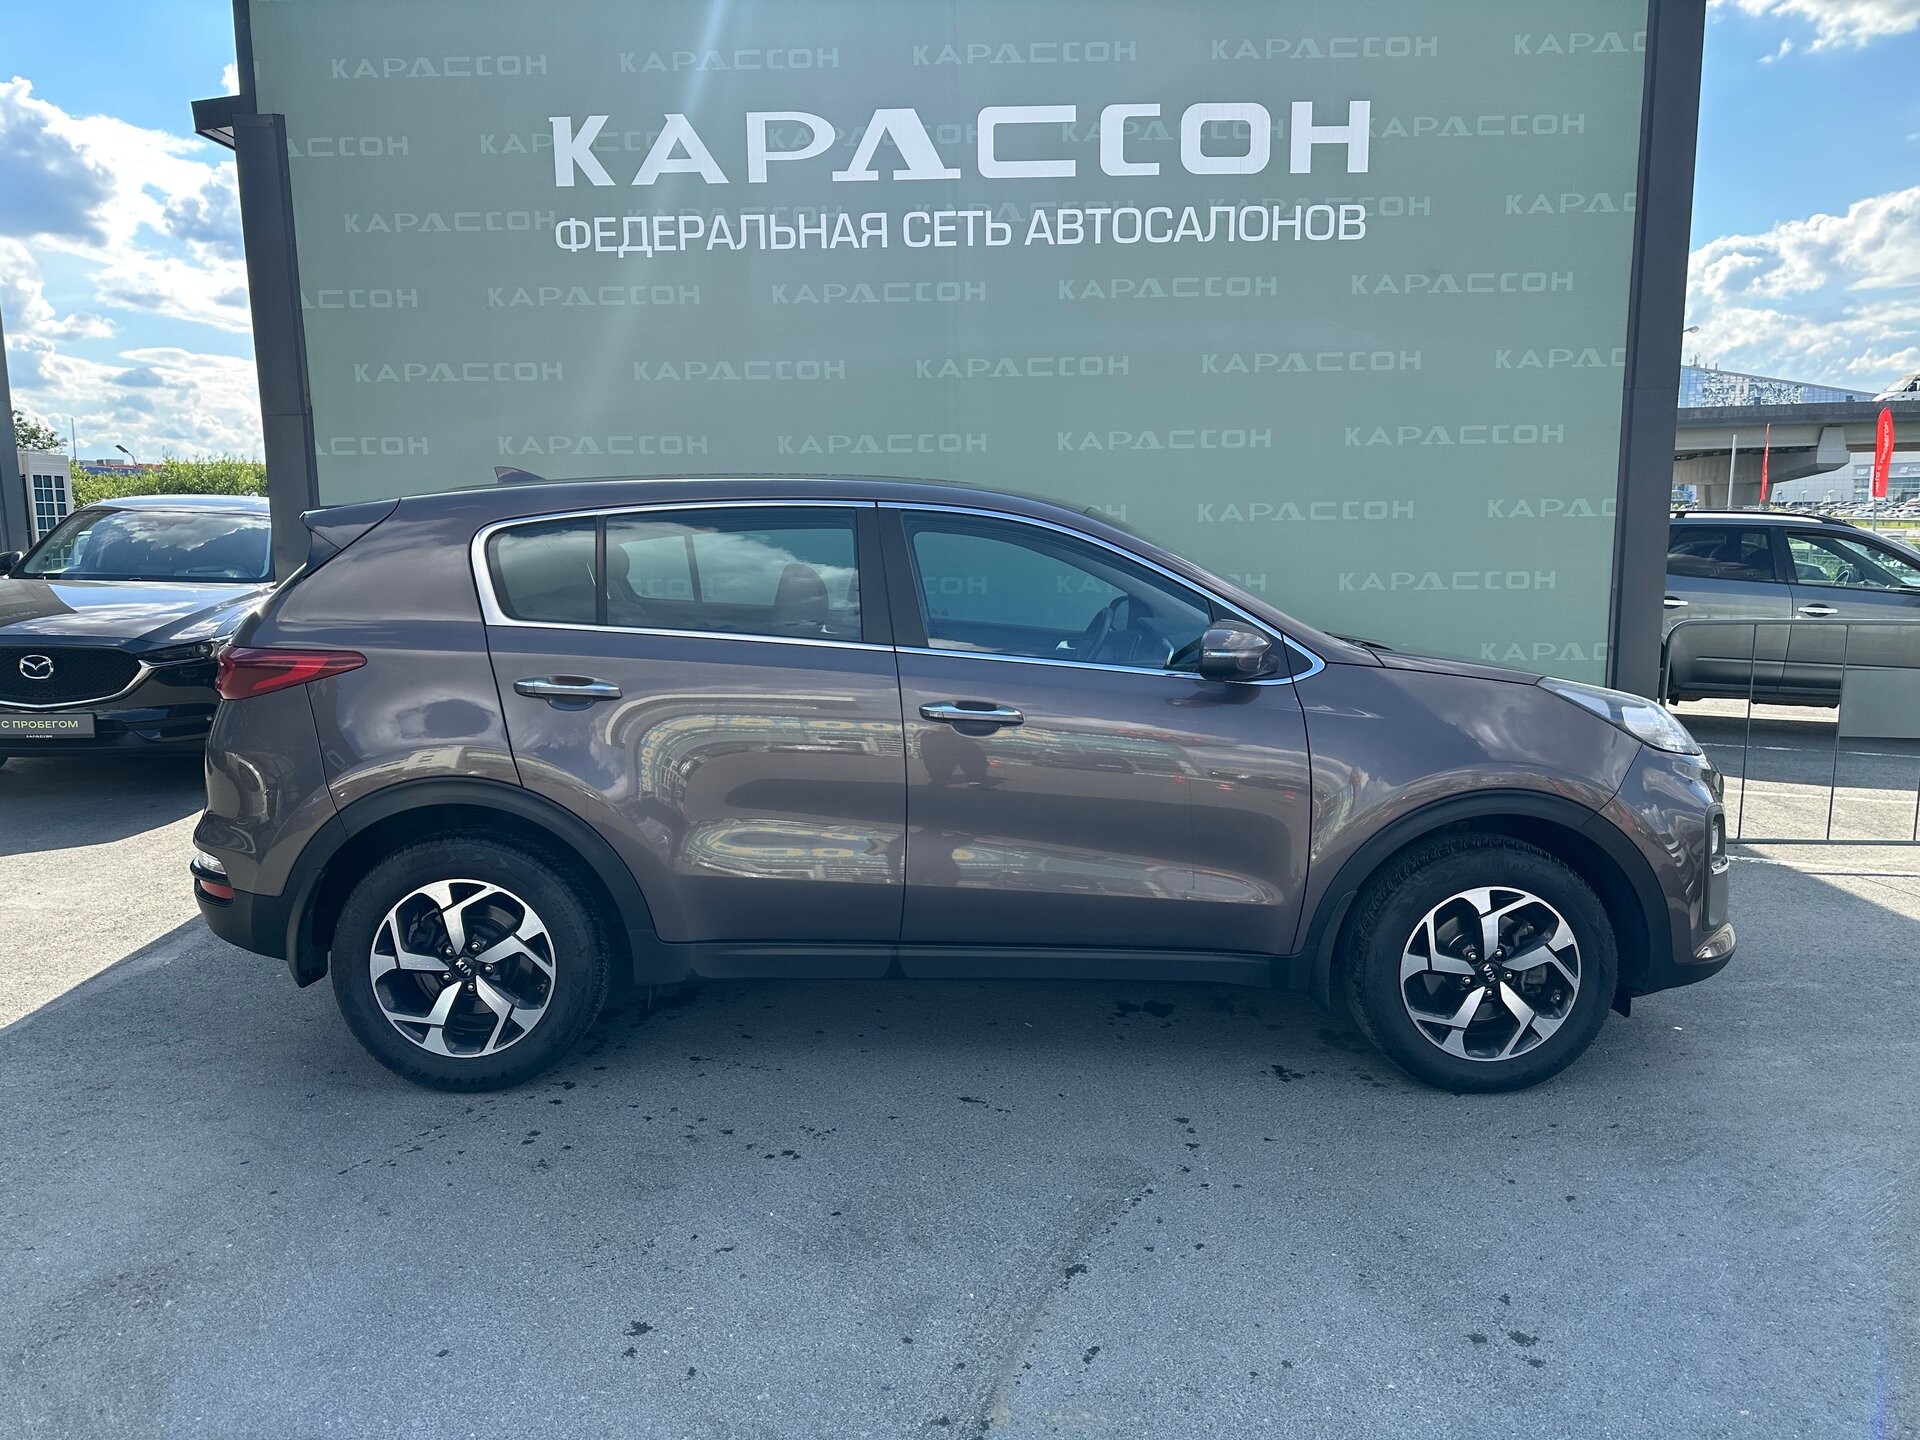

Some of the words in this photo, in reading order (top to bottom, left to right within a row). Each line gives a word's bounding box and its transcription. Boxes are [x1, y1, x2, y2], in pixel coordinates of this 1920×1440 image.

[555, 213, 888, 258] ФЕДЕРАЛЬНАЯ
[903, 210, 1013, 248] СЕТЬ
[1024, 205, 1367, 247] АВТОСАЛОНОВ
[1, 720, 10, 729] С
[12, 720, 79, 729] ПРОБЕГОМ
[456, 958, 472, 976] KIA
[1483, 964, 1496, 983] KIA
